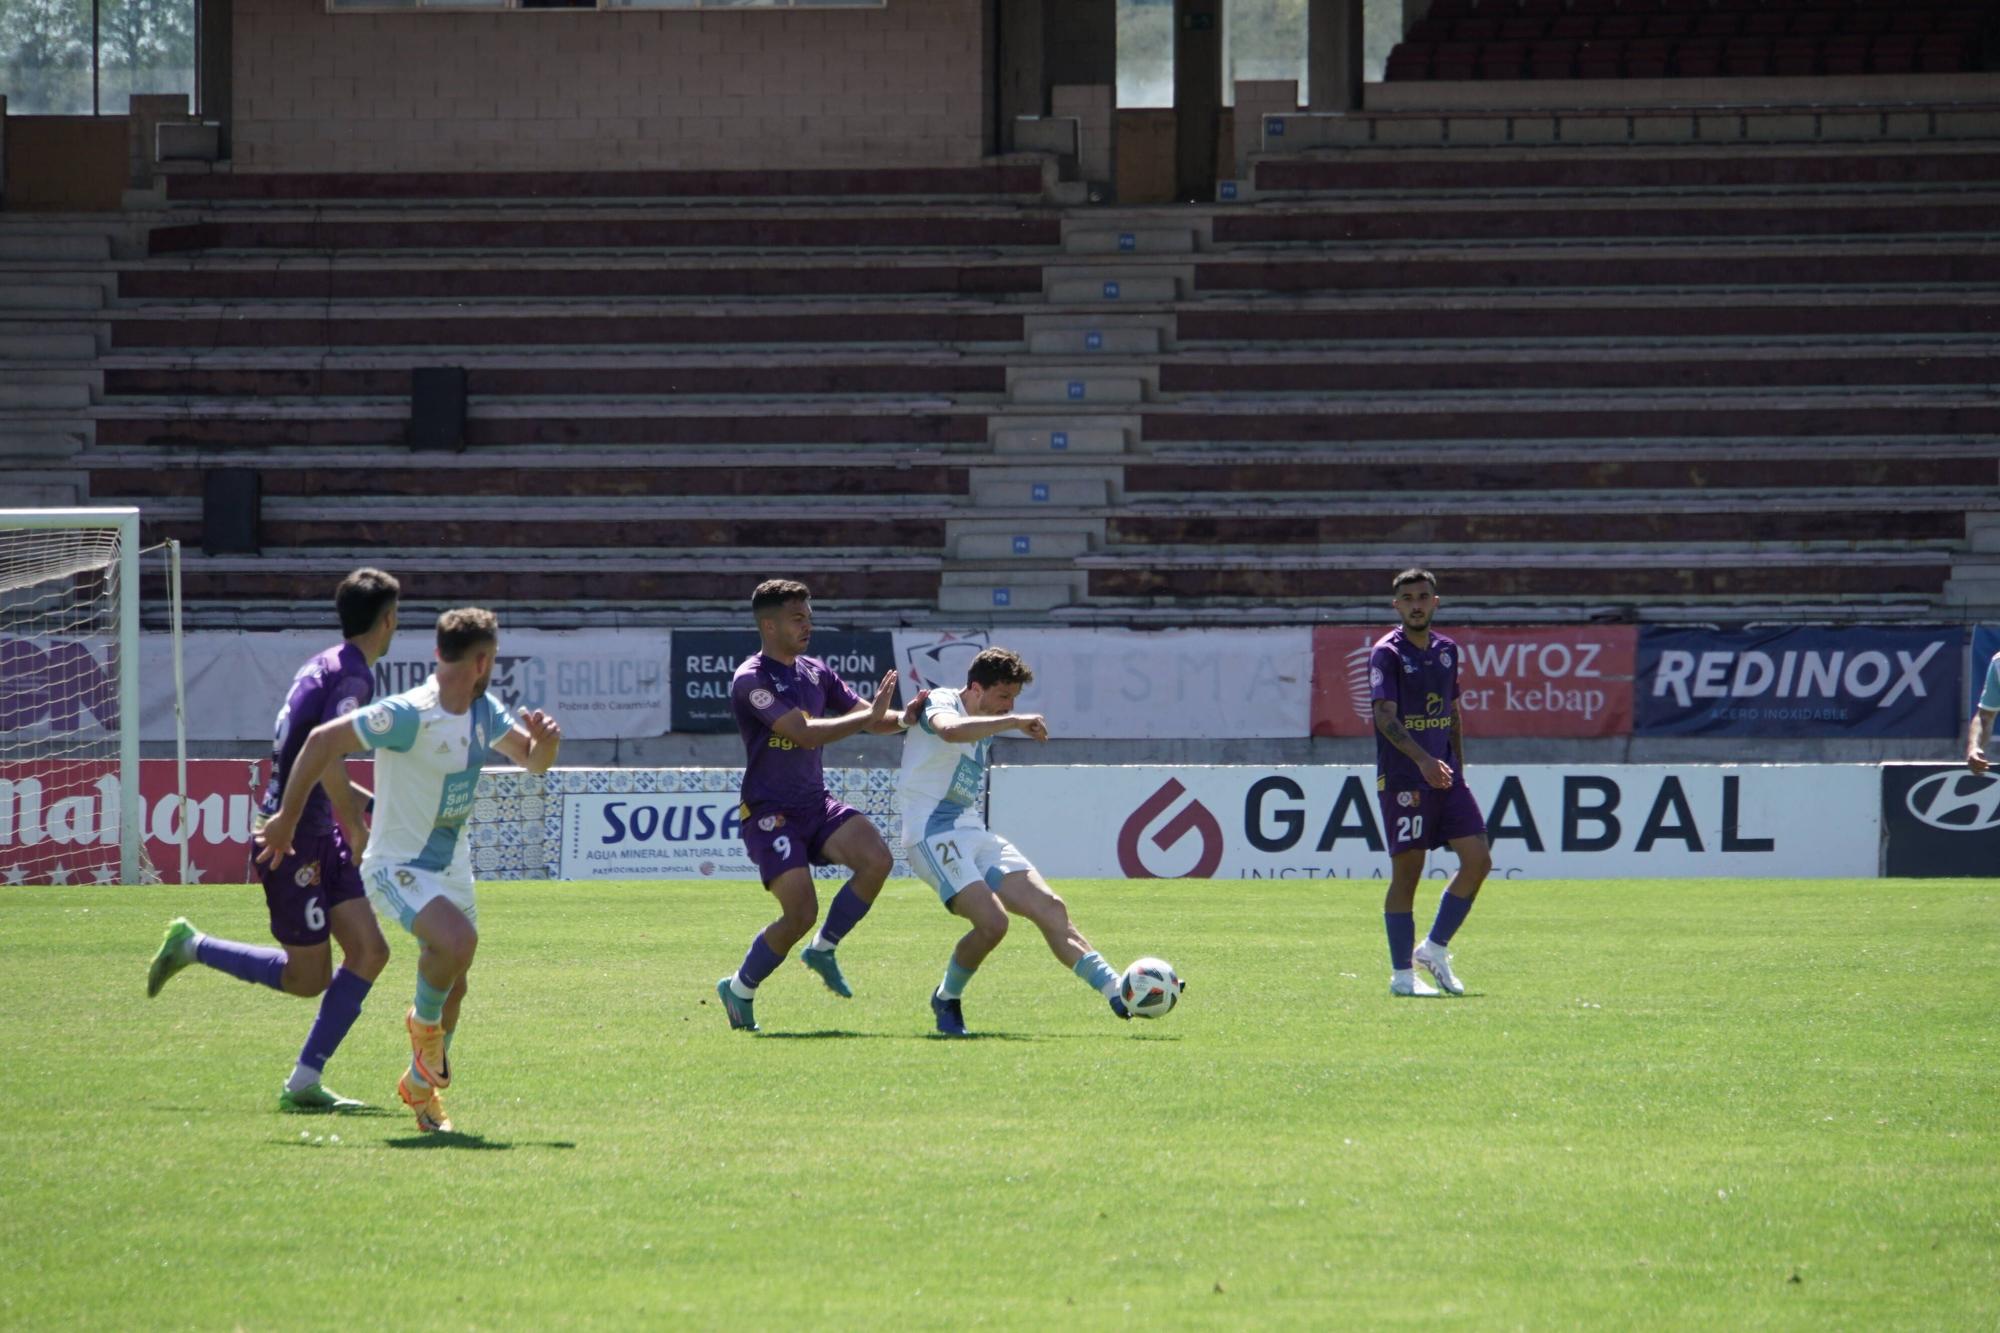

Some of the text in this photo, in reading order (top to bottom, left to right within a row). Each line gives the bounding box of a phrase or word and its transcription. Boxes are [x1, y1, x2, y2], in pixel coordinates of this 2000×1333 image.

[686, 655, 736, 673] REAL
[1653, 641, 1945, 707] REDINOX
[375, 662, 438, 697] NTR
[1504, 681, 1604, 720] kebap
[1711, 708, 1848, 720] ACERO INOXIDABLE
[1244, 775, 1775, 853] GAABAL
[1397, 815, 1423, 841] 20
[586, 847, 744, 860] AGUA MINERAL NATURAL DE
[773, 835, 791, 861] 9
[935, 840, 962, 865] 21
[304, 896, 326, 931] 6
